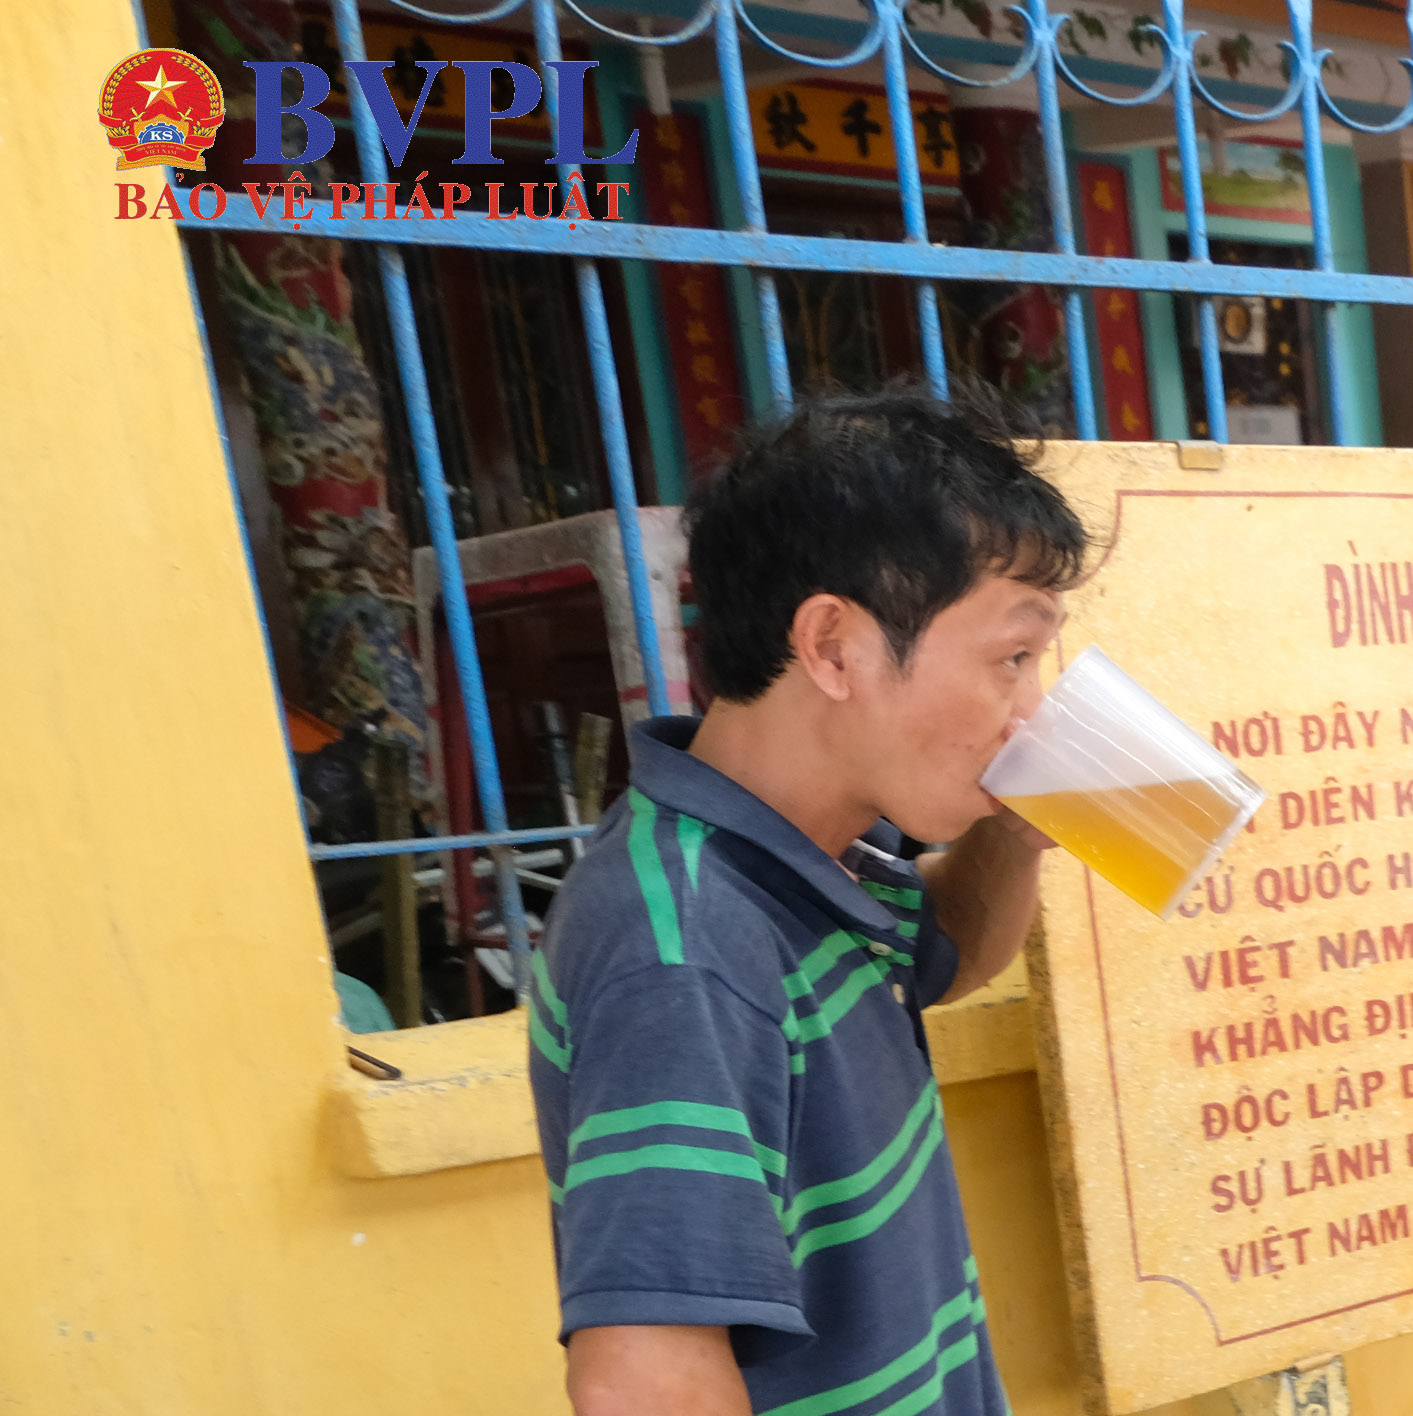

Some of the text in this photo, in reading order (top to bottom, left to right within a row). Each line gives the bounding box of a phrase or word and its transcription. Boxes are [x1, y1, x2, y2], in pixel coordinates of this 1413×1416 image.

[1211, 711, 1283, 758] NƠI
[1299, 701, 1380, 753] ĐÂY
[1279, 777, 1376, 830] DIÊN
[1254, 851, 1371, 912] QUỐC
[1183, 936, 1295, 992] VIỆT
[1200, 1086, 1291, 1141] ĐỘC
[1306, 1067, 1385, 1119] LẬP
[1210, 1158, 1266, 1214] SỰ
[1283, 1139, 1391, 1197] LÃNH
[1219, 1226, 1311, 1282] VIỆT
[1327, 1204, 1411, 1257] NAM
